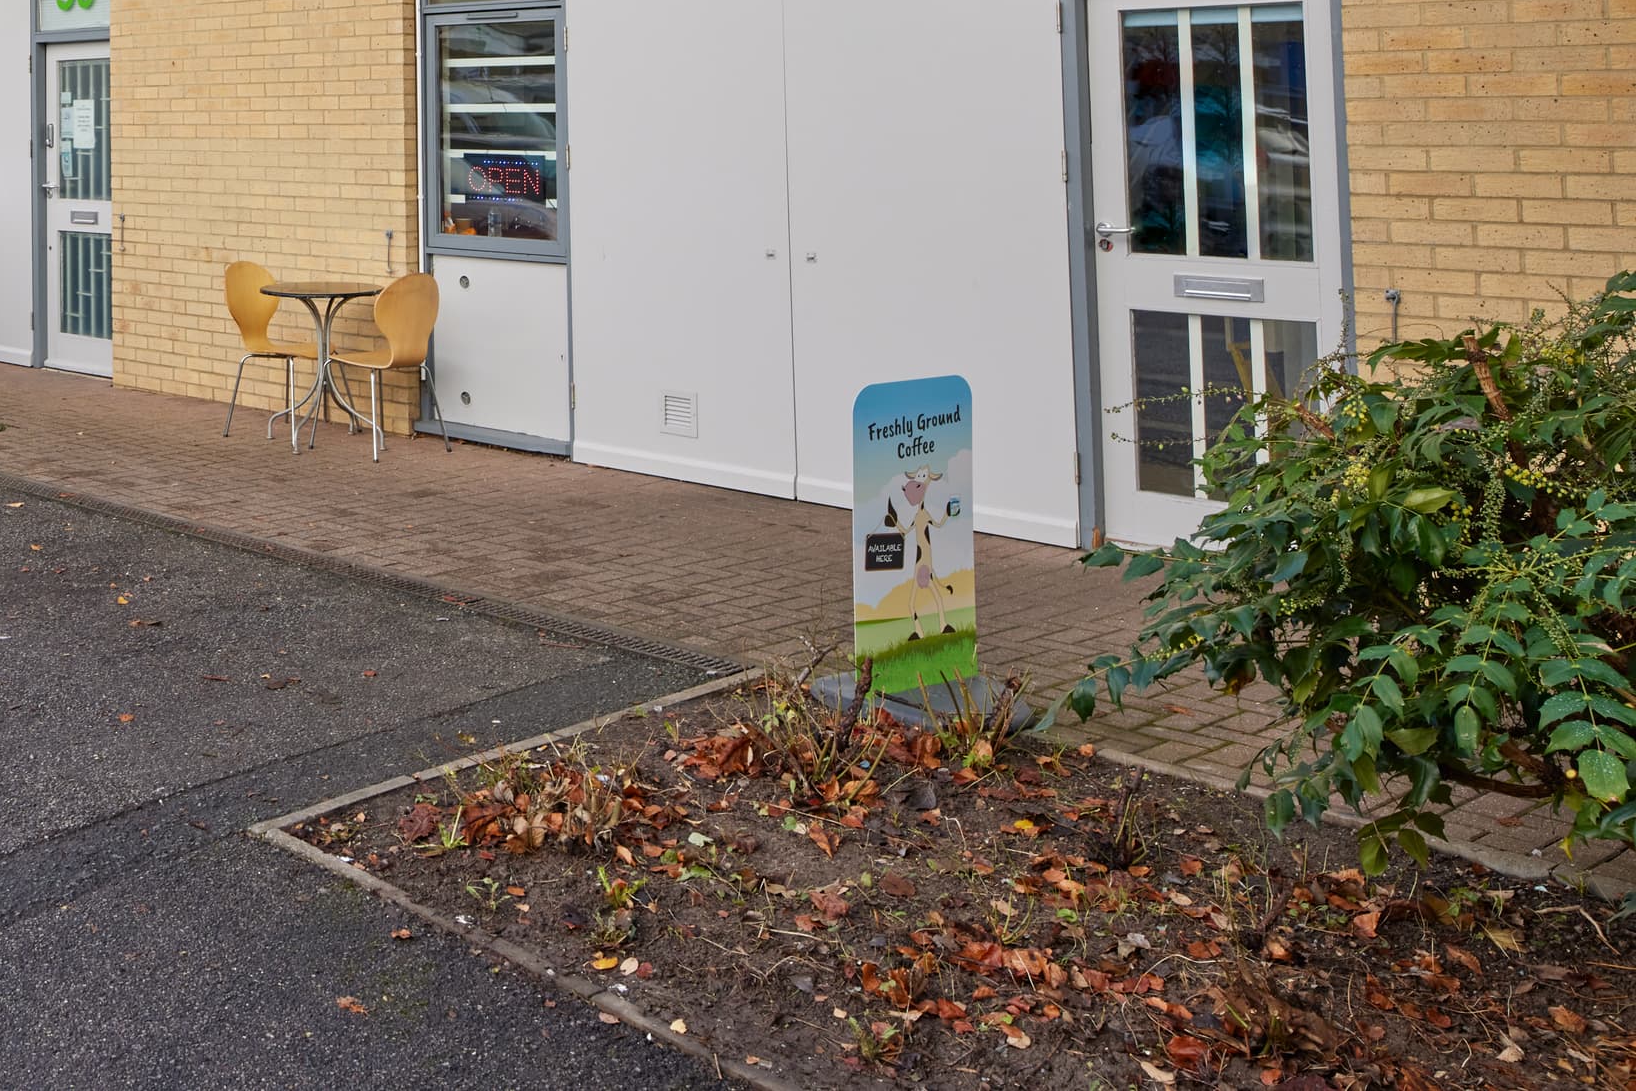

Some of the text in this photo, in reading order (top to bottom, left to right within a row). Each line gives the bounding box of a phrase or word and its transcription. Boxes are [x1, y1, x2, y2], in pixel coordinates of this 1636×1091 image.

[468, 165, 540, 196] OPEN
[868, 404, 961, 441] Freshly Ground
[897, 435, 935, 459] Coffee
[868, 543, 902, 554] AVAILABLE
[876, 554, 893, 563] HERE
